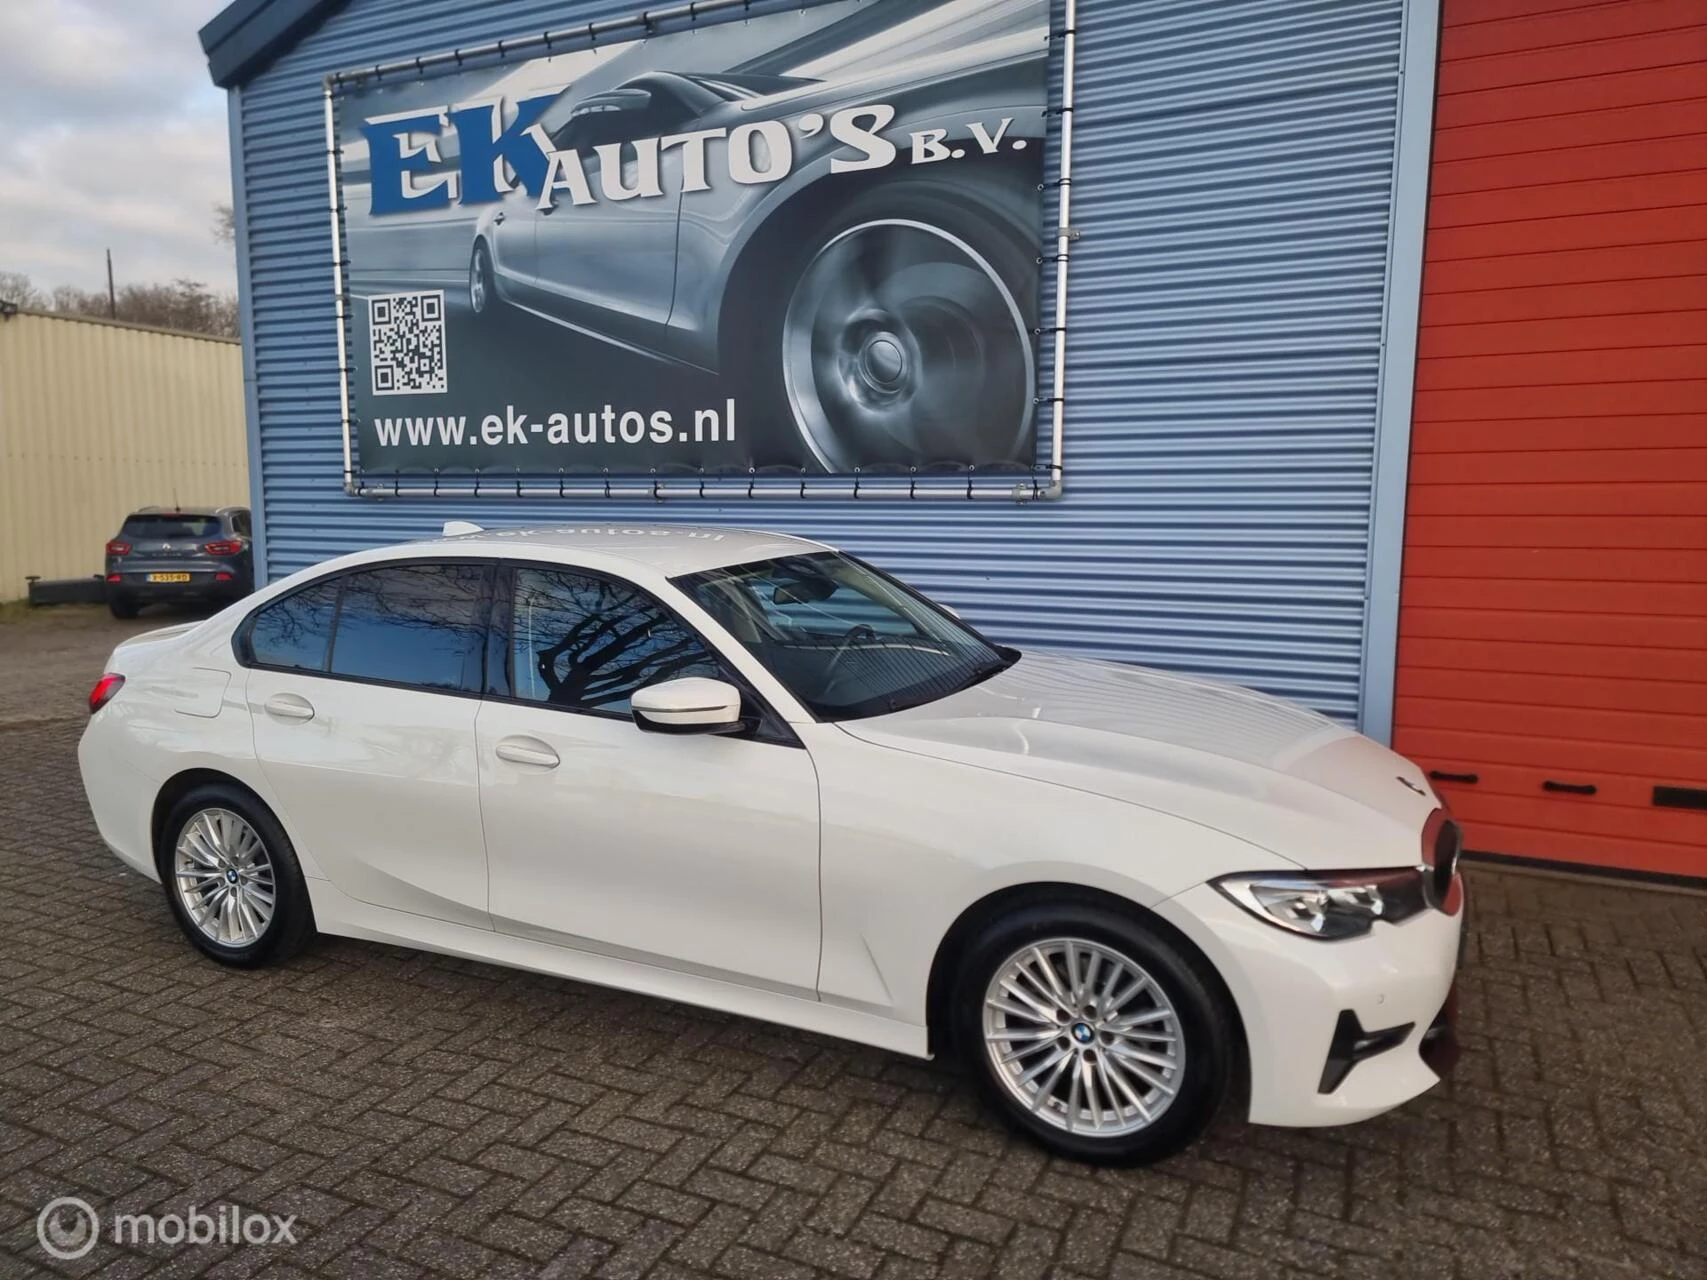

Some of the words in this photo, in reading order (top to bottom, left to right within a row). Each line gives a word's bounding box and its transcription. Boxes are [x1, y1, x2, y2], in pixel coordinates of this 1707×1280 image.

[361, 85, 571, 215] EK
[910, 117, 1027, 165] B.V.
[374, 399, 736, 446] www.ek-autos.nl
